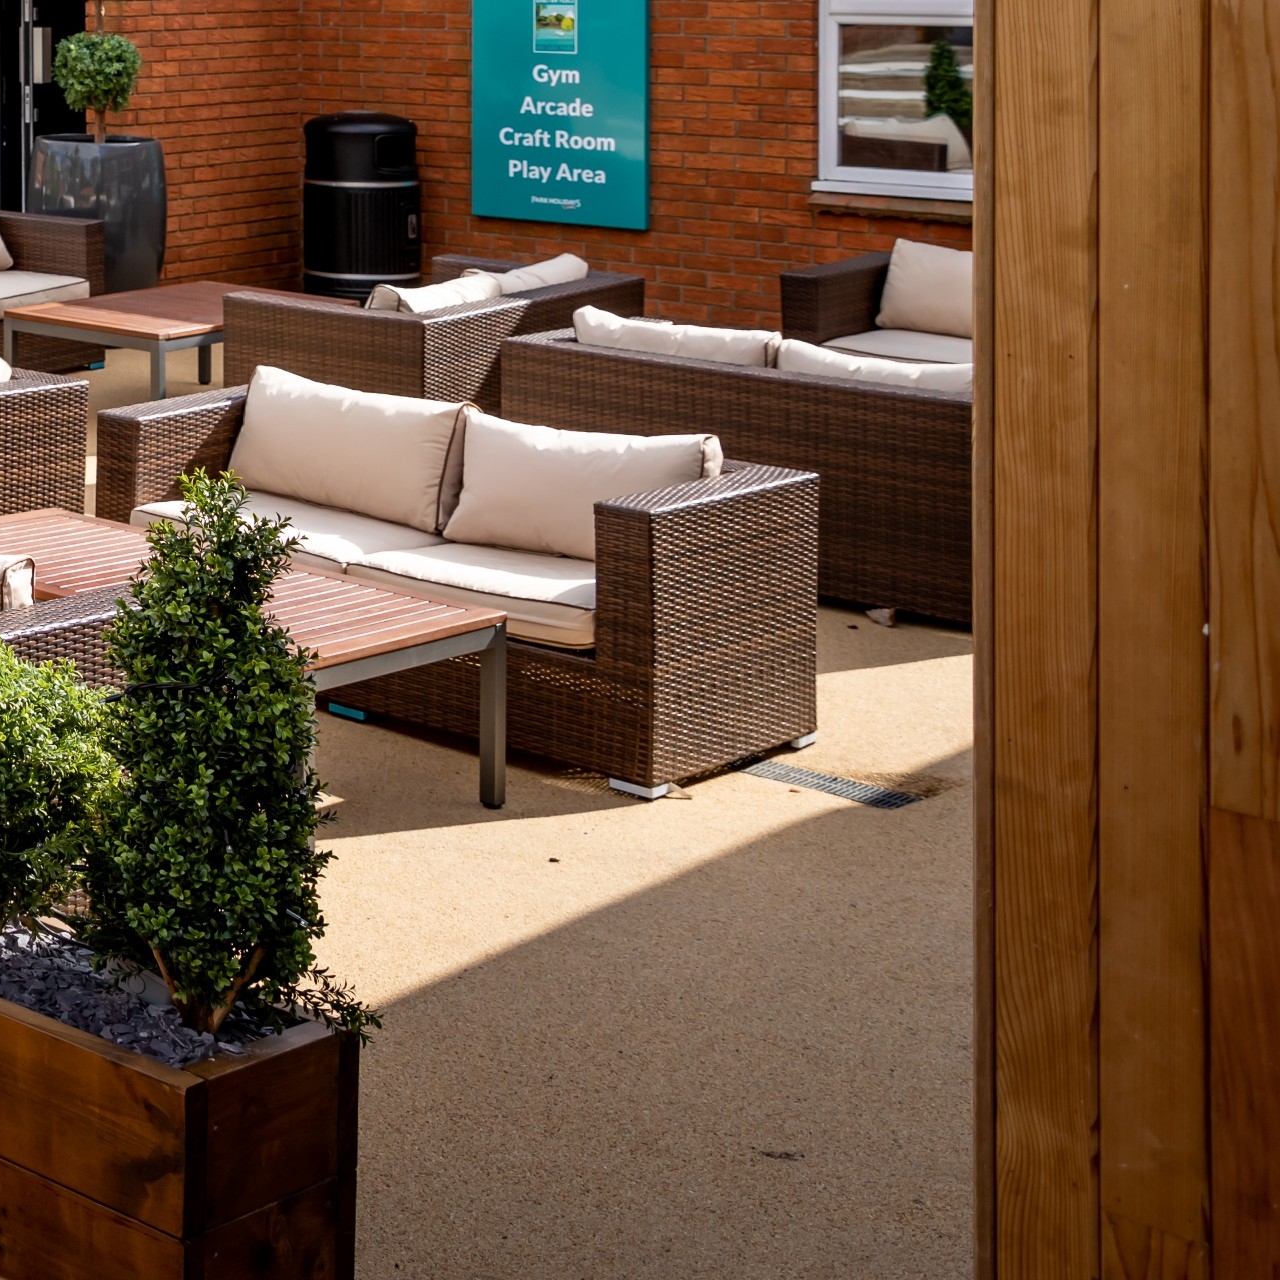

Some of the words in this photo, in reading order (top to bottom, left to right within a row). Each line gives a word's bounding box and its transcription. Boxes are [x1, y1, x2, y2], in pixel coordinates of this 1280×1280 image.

[532, 64, 581, 87] Gym
[520, 96, 594, 117] Arcade
[499, 127, 551, 147] Craft
[555, 130, 616, 151] Room
[508, 160, 552, 183] Play
[556, 163, 606, 184] Area
